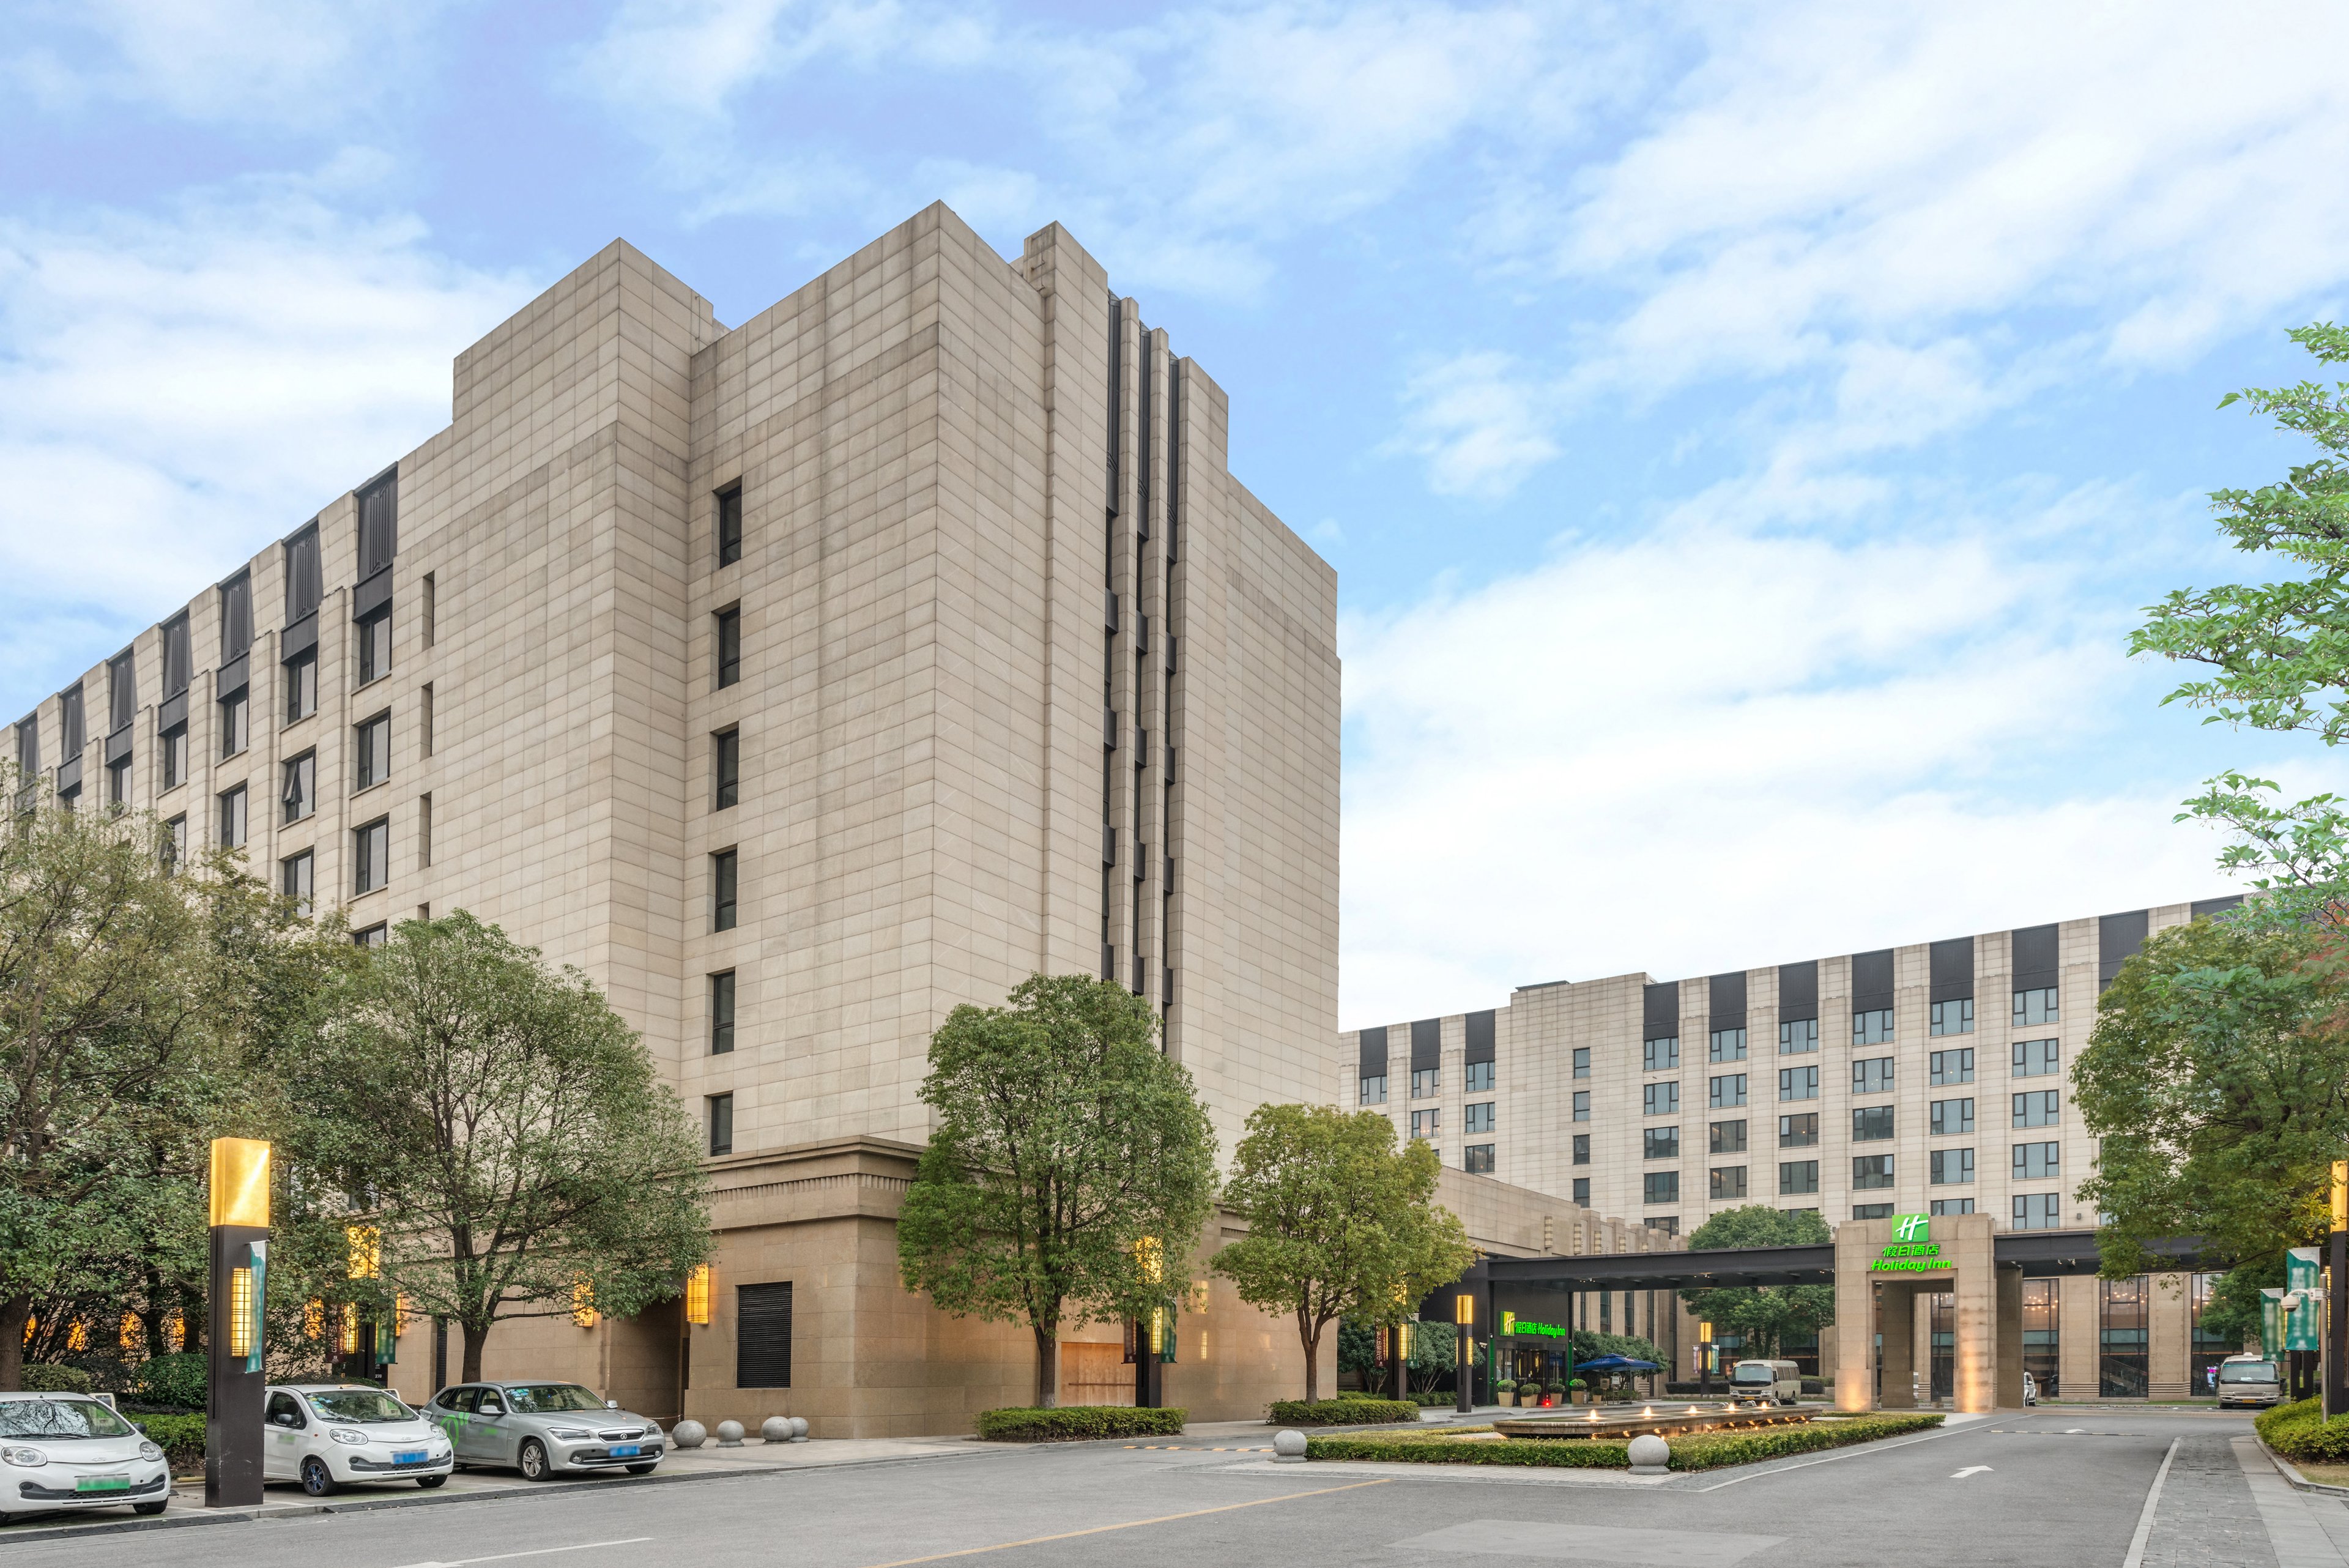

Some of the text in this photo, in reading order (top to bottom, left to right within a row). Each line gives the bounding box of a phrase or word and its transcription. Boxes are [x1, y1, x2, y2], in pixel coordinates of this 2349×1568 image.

[1882, 1244, 1940, 1257] 假日酒店
[1871, 1257, 1951, 1272] Holiday Inn
[1515, 1321, 1537, 1334] 假日酒店
[1538, 1322, 1557, 1339] Holiday
